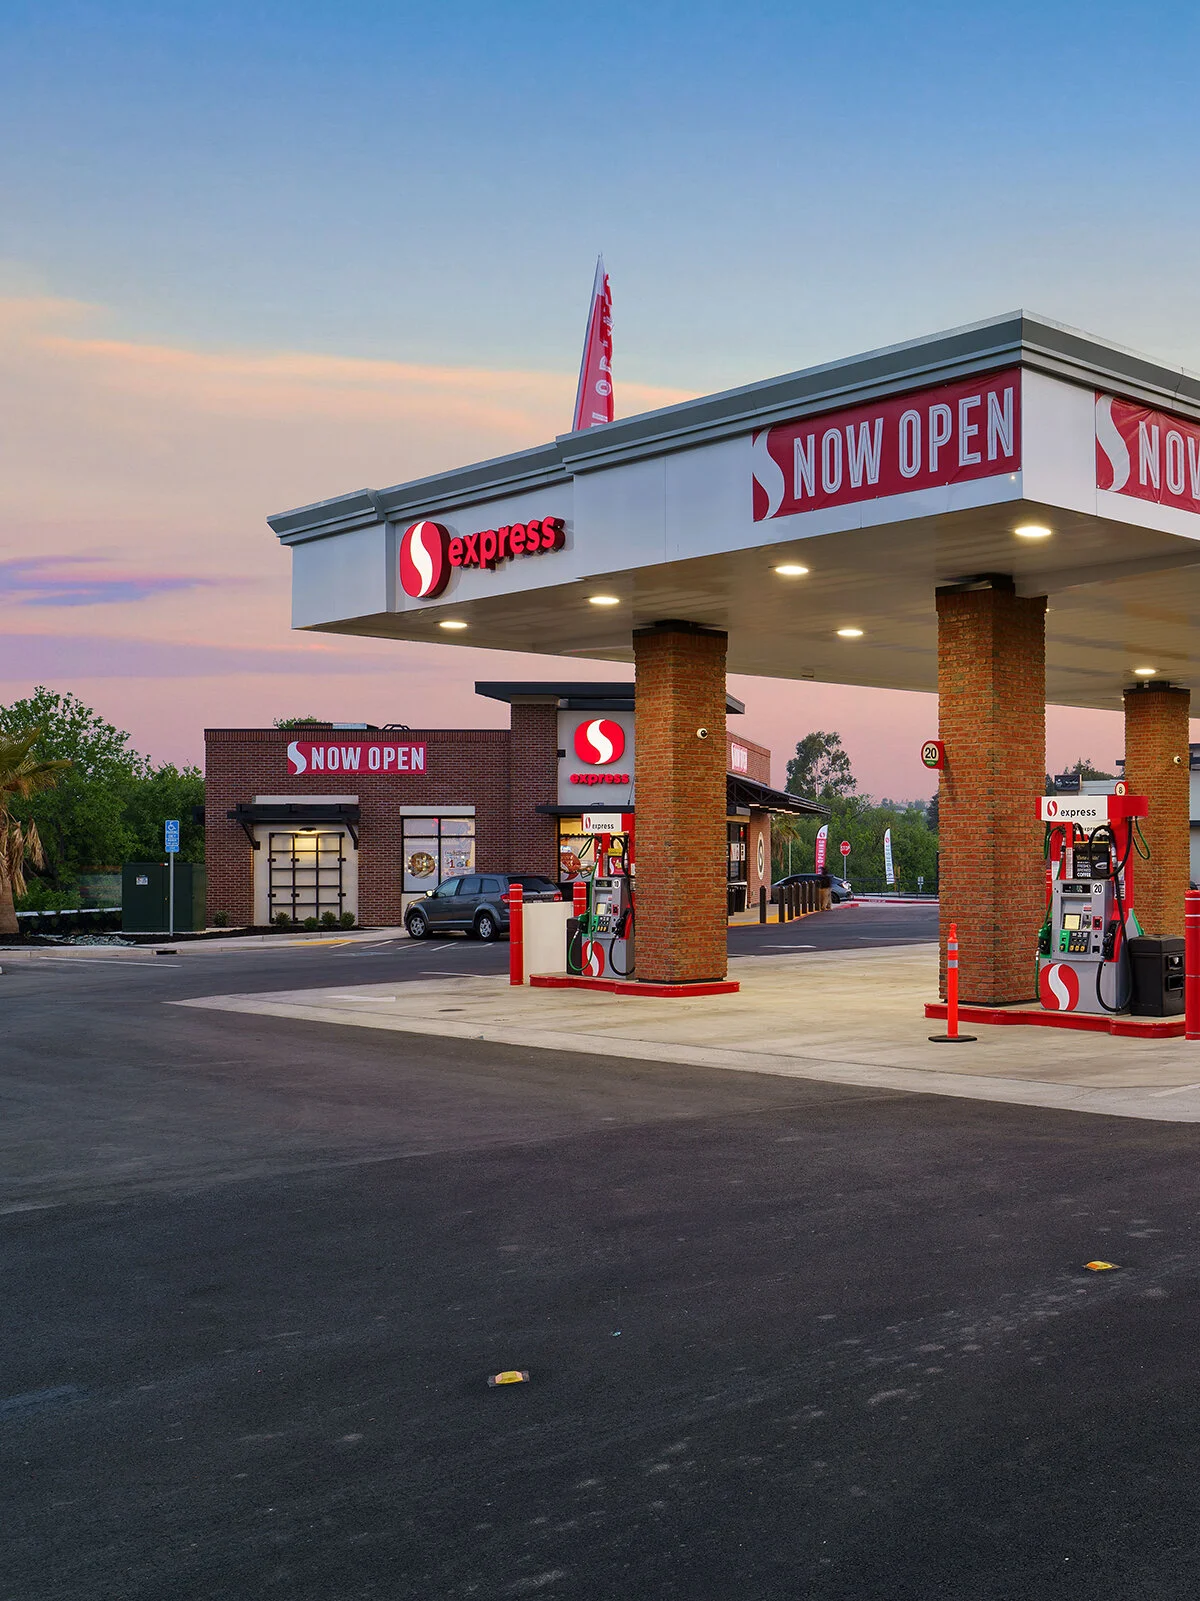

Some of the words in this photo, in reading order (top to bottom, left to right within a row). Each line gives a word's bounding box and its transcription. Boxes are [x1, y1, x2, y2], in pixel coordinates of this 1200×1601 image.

[793, 417, 884, 500] NOW
[899, 387, 1014, 478] OPEN
[449, 515, 560, 569] express
[311, 746, 361, 770] NOW
[368, 746, 424, 770] OPEN
[925, 747, 937, 759] 20
[569, 773, 630, 786] express
[1060, 808, 1097, 818] express
[1094, 884, 1102, 893] 20
